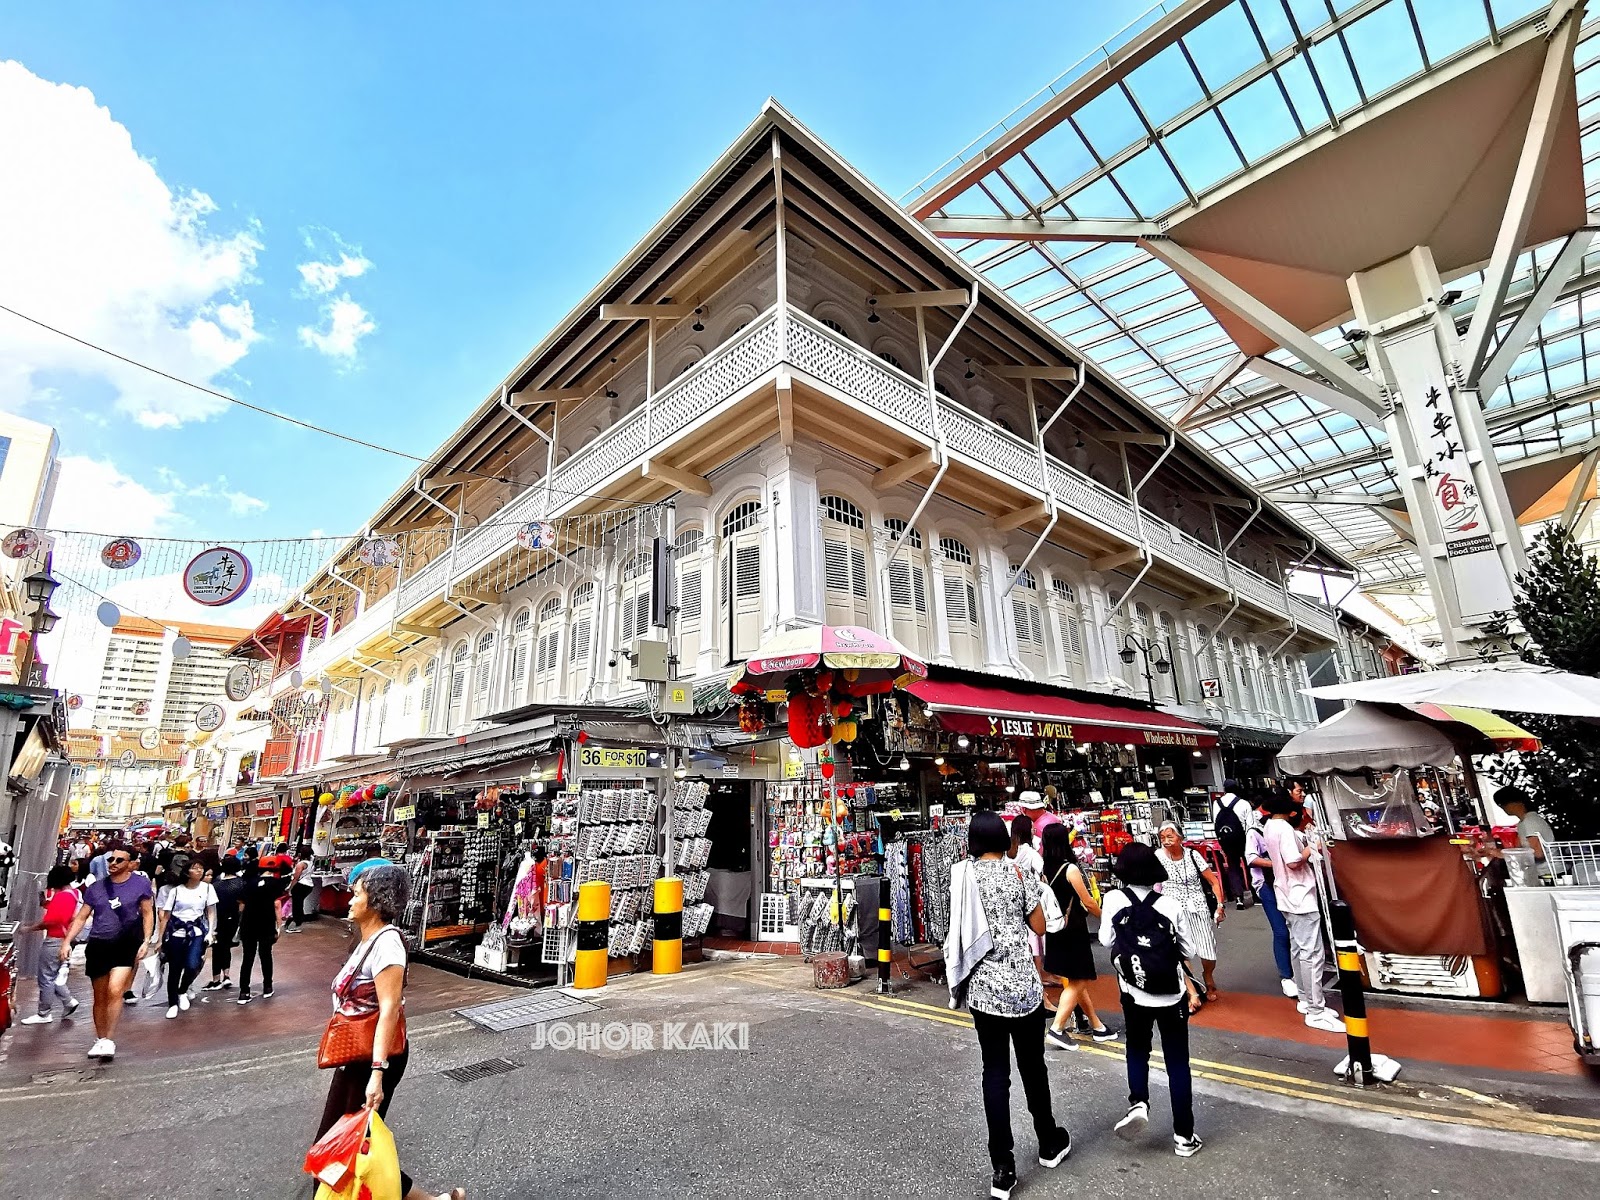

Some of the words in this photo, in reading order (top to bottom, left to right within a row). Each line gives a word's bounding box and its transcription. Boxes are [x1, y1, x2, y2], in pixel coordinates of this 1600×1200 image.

[1447, 537, 1490, 549] Chinatown
[1449, 548, 1468, 556] Food
[1470, 544, 1493, 552] Street
[1001, 719, 1034, 737] LESLIE
[1037, 722, 1074, 739] JAVELLE
[1143, 731, 1175, 745] Wholesale
[1175, 733, 1181, 745] &
[1181, 733, 1199, 746] Retail
[582, 749, 601, 766] 36
[605, 751, 625, 761] FOR
[626, 752, 646, 767] $10
[931, 807, 942, 815] $10
